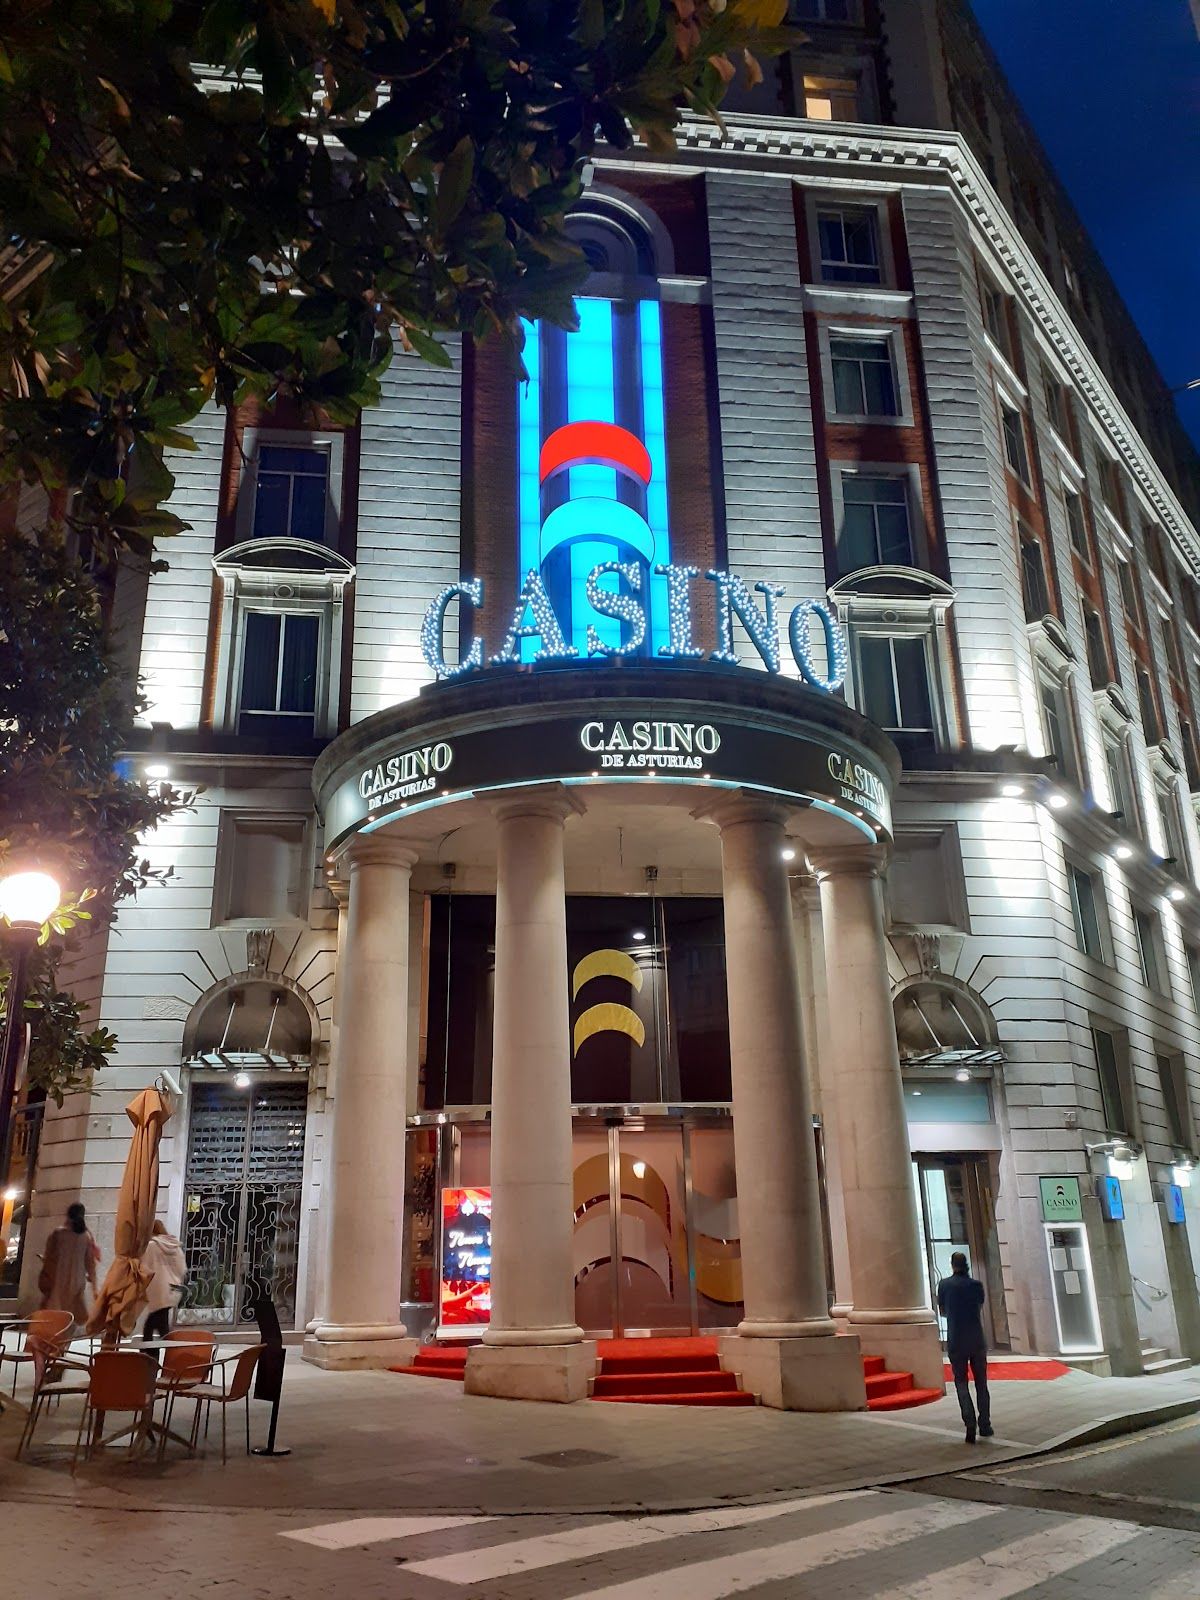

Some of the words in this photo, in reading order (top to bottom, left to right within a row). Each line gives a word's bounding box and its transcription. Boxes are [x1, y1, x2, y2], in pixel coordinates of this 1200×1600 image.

[420, 560, 848, 693] CASINO
[580, 721, 721, 754] CASINO
[359, 743, 452, 798] CASINO
[601, 754, 624, 767] DE
[626, 754, 703, 769] ASTURIAS
[368, 795, 382, 811] DE
[382, 777, 436, 804] ASTURIAS
[827, 752, 885, 806] CASINO
[840, 785, 854, 801] DE
[1046, 1199, 1078, 1207] CASINO
